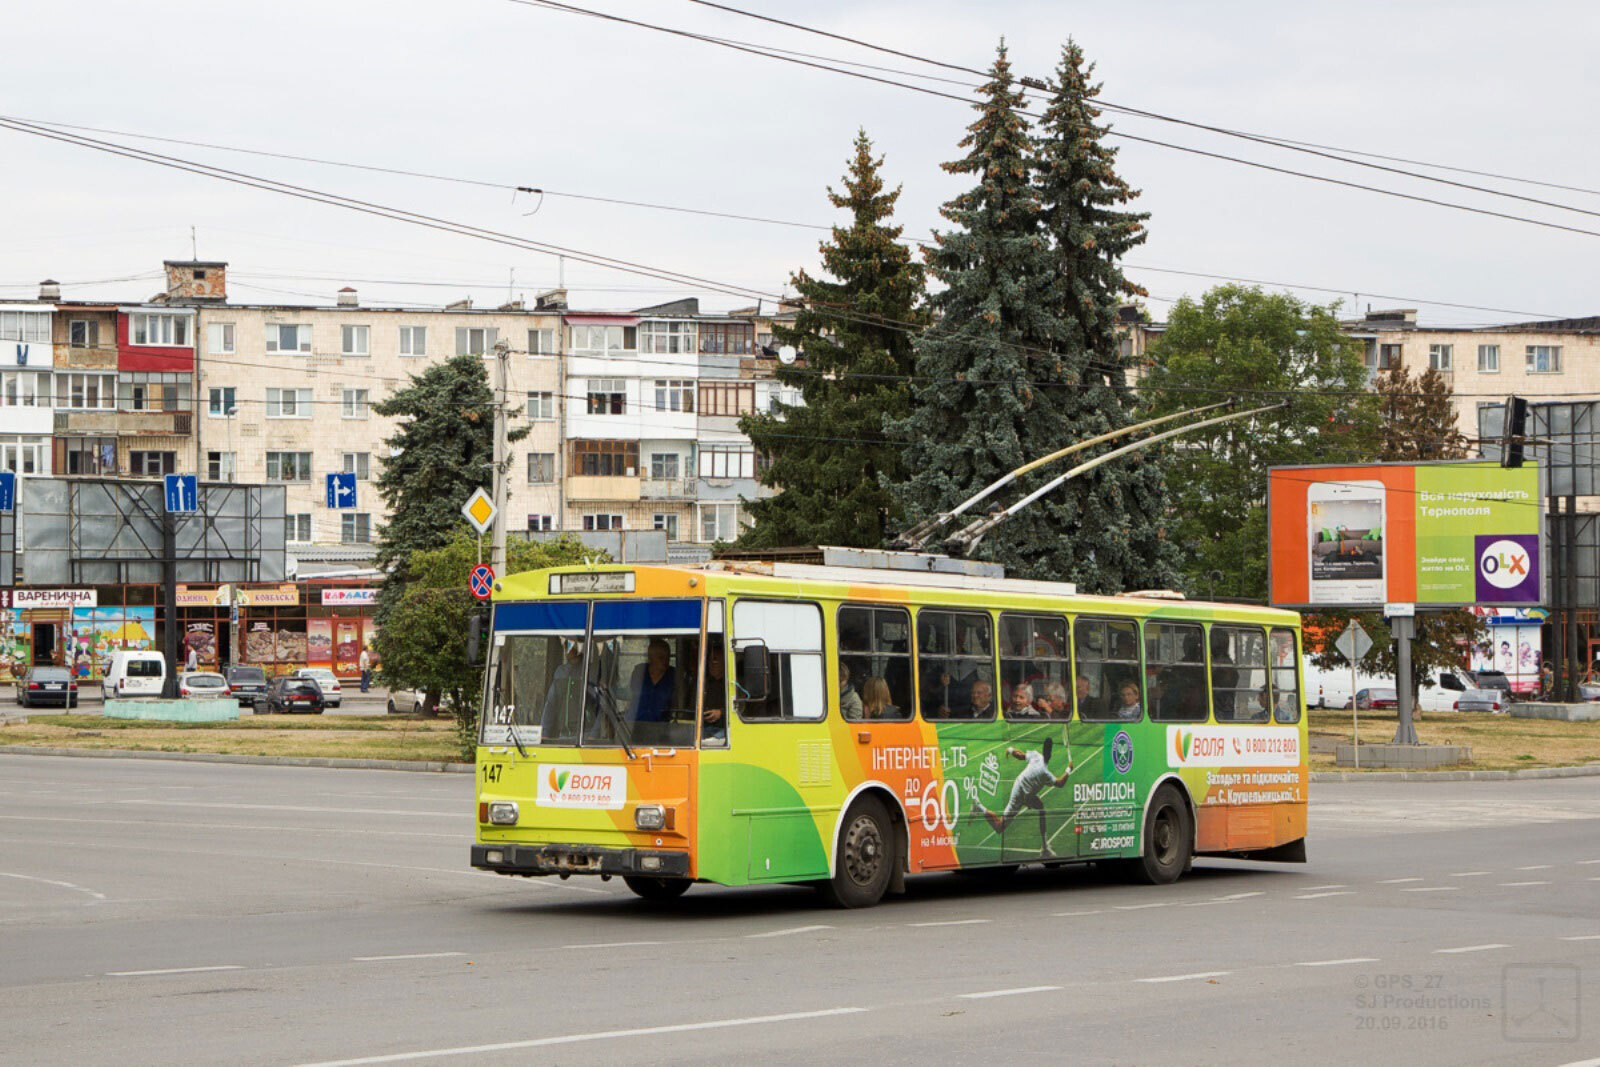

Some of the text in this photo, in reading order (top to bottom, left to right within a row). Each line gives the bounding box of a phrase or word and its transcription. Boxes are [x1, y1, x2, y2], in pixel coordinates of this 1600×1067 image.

[1420, 491, 1444, 501] Вся
[1420, 506, 1491, 518] Тернополя
[1482, 552, 1526, 575] OLX
[18, 591, 91, 602] ВАРЕНИЧНА
[494, 704, 515, 724] 147
[1192, 737, 1225, 756] ВОЛЯ
[1268, 738, 1282, 753] 212
[872, 746, 938, 770] ІНТЕРНЕТ
[950, 746, 967, 768] ТБ
[482, 764, 503, 783] 147
[571, 774, 612, 790] ВОЛЯ
[1073, 781, 1136, 803] ВІМБЛДОН
[930, 835, 936, 846] 4
